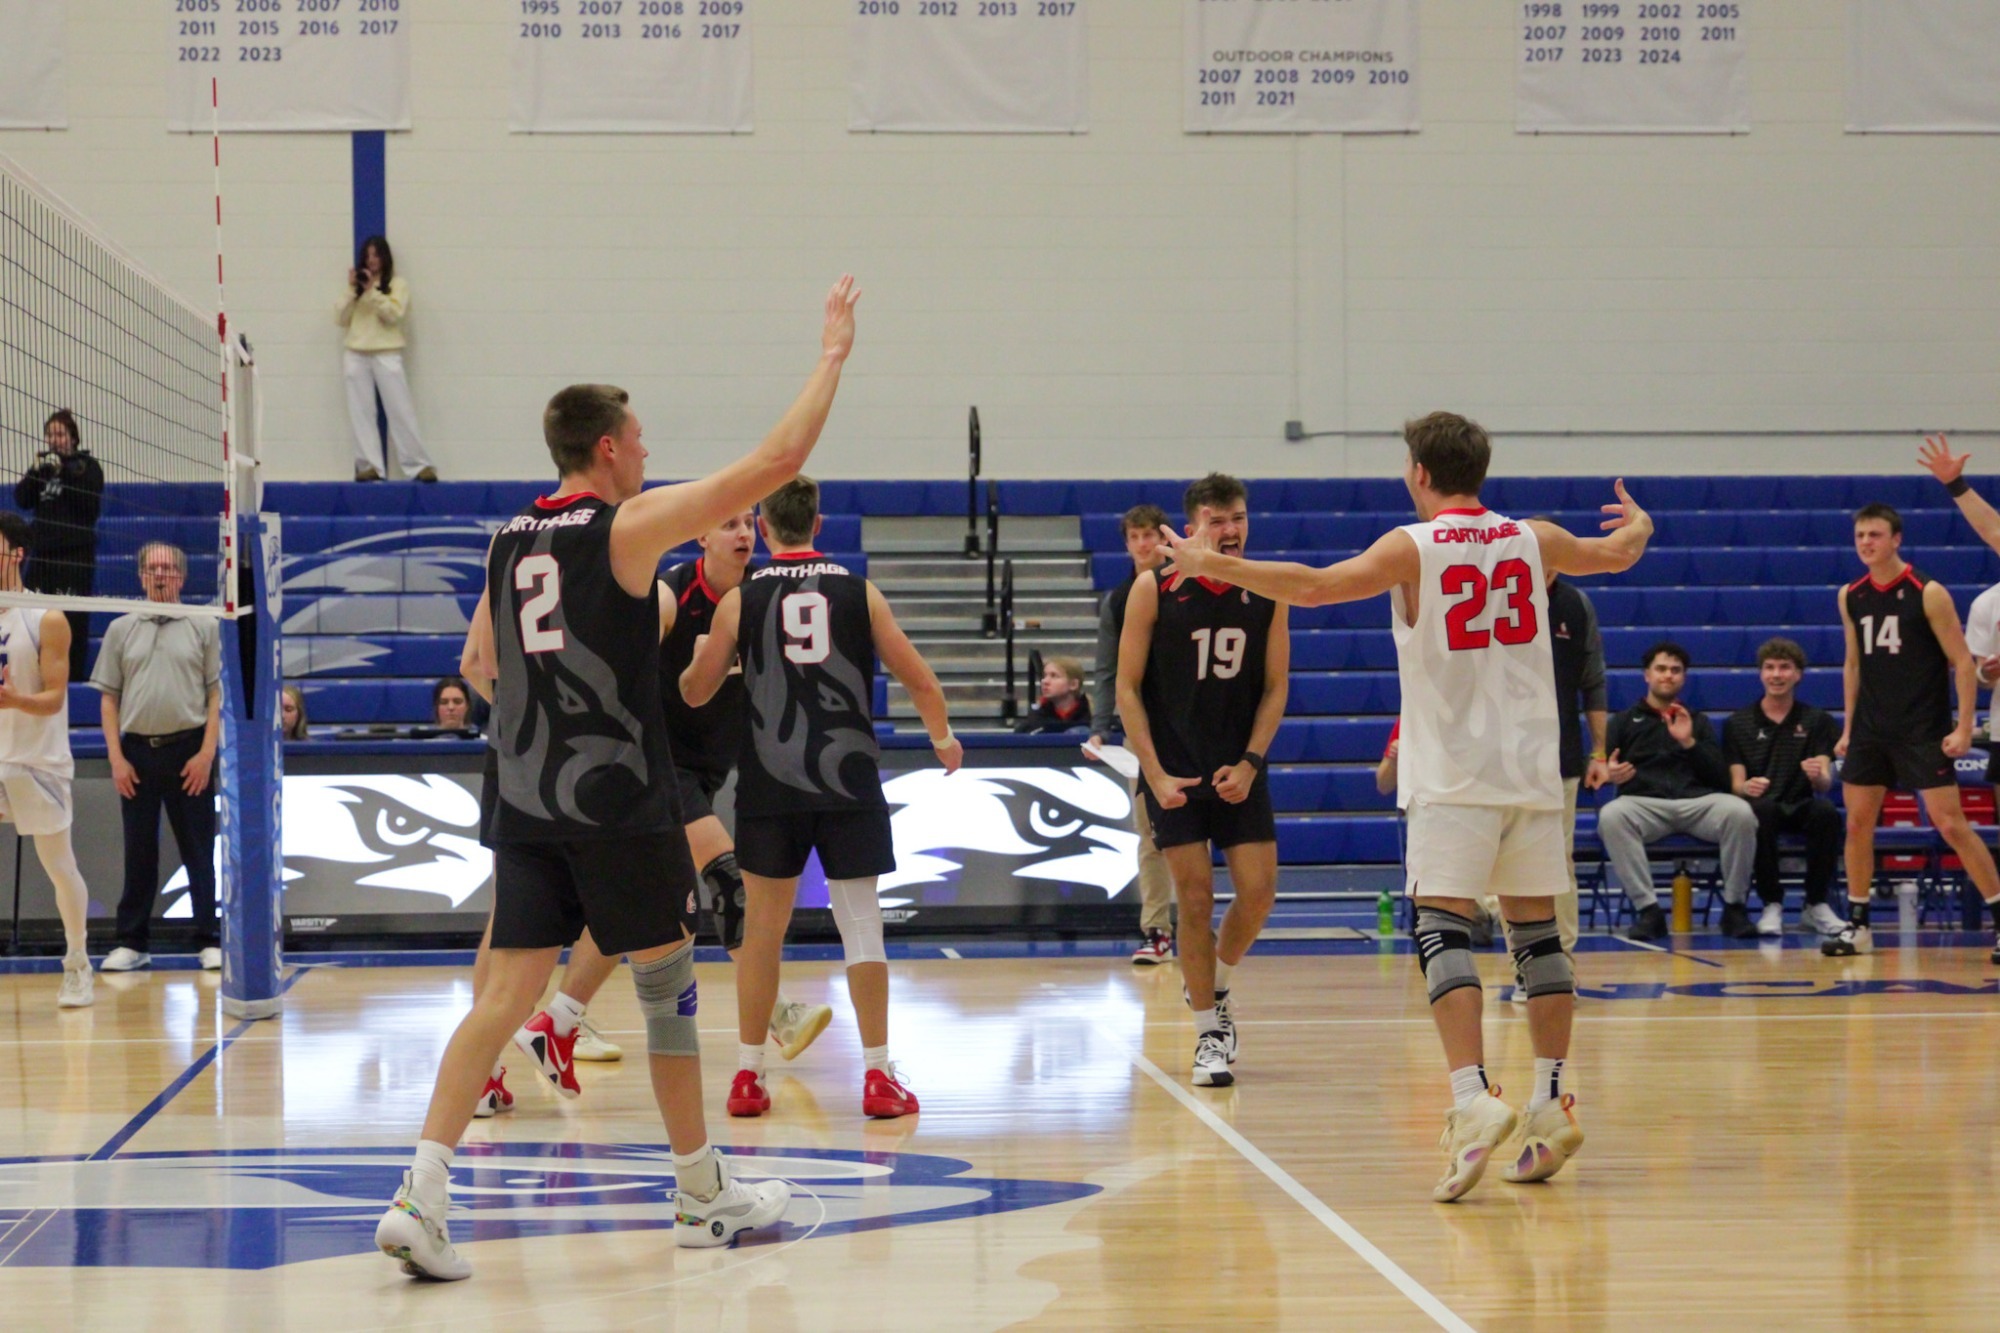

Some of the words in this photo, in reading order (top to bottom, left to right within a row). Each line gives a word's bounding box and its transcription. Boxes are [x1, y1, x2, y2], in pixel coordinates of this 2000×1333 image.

[175, 0, 221, 13] 2005
[236, 0, 282, 13] 2006
[297, 0, 341, 12] 2007
[358, 0, 400, 12] 2010
[521, 0, 560, 15] 1995
[579, 0, 623, 16] 2007
[638, 0, 684, 16] 2008
[699, 0, 744, 16] 2009
[858, 0, 900, 16] 2010
[919, 1, 958, 17] 2012
[978, 1, 1017, 17] 2013
[1037, 1, 1076, 17] 2017
[1524, 3, 1562, 18] 1998
[1582, 3, 1620, 18] 1999
[1638, 3, 1681, 19] 2002
[1697, 3, 1740, 19] 2005
[179, 20, 216, 36] 2011
[239, 20, 280, 36] 2015
[299, 20, 340, 36] 2016
[359, 19, 399, 35] 2017
[520, 22, 562, 39] 2010
[581, 23, 621, 39] 2013
[641, 23, 682, 39] 2016
[701, 23, 741, 39] 2017
[1523, 25, 1567, 41] 2007
[1581, 26, 1625, 41] 2009
[1640, 26, 1681, 42] 2010
[1701, 26, 1736, 41] 2011
[178, 46, 220, 62] 2022
[239, 46, 282, 62] 2023
[1212, 49, 1295, 63] OUTDOOR
[1298, 50, 1394, 64] CHAMPIONS
[1525, 46, 1564, 63] 2017
[1582, 47, 1622, 63] 2023
[1639, 48, 1681, 64] 2024
[1199, 68, 1242, 85] 2007
[1254, 68, 1299, 84] 2008
[1311, 69, 1356, 84] 2009
[1368, 69, 1410, 85] 2010
[1200, 90, 1236, 106] 2011
[1257, 90, 1295, 106] 2021
[1432, 522, 1522, 545] CARTHAGE
[751, 563, 850, 580] CARTHAGE
[514, 553, 565, 654] 2
[1440, 557, 1539, 651] 23
[782, 592, 831, 664] 9
[1859, 614, 1902, 655] 14
[1190, 627, 1247, 680] 19
